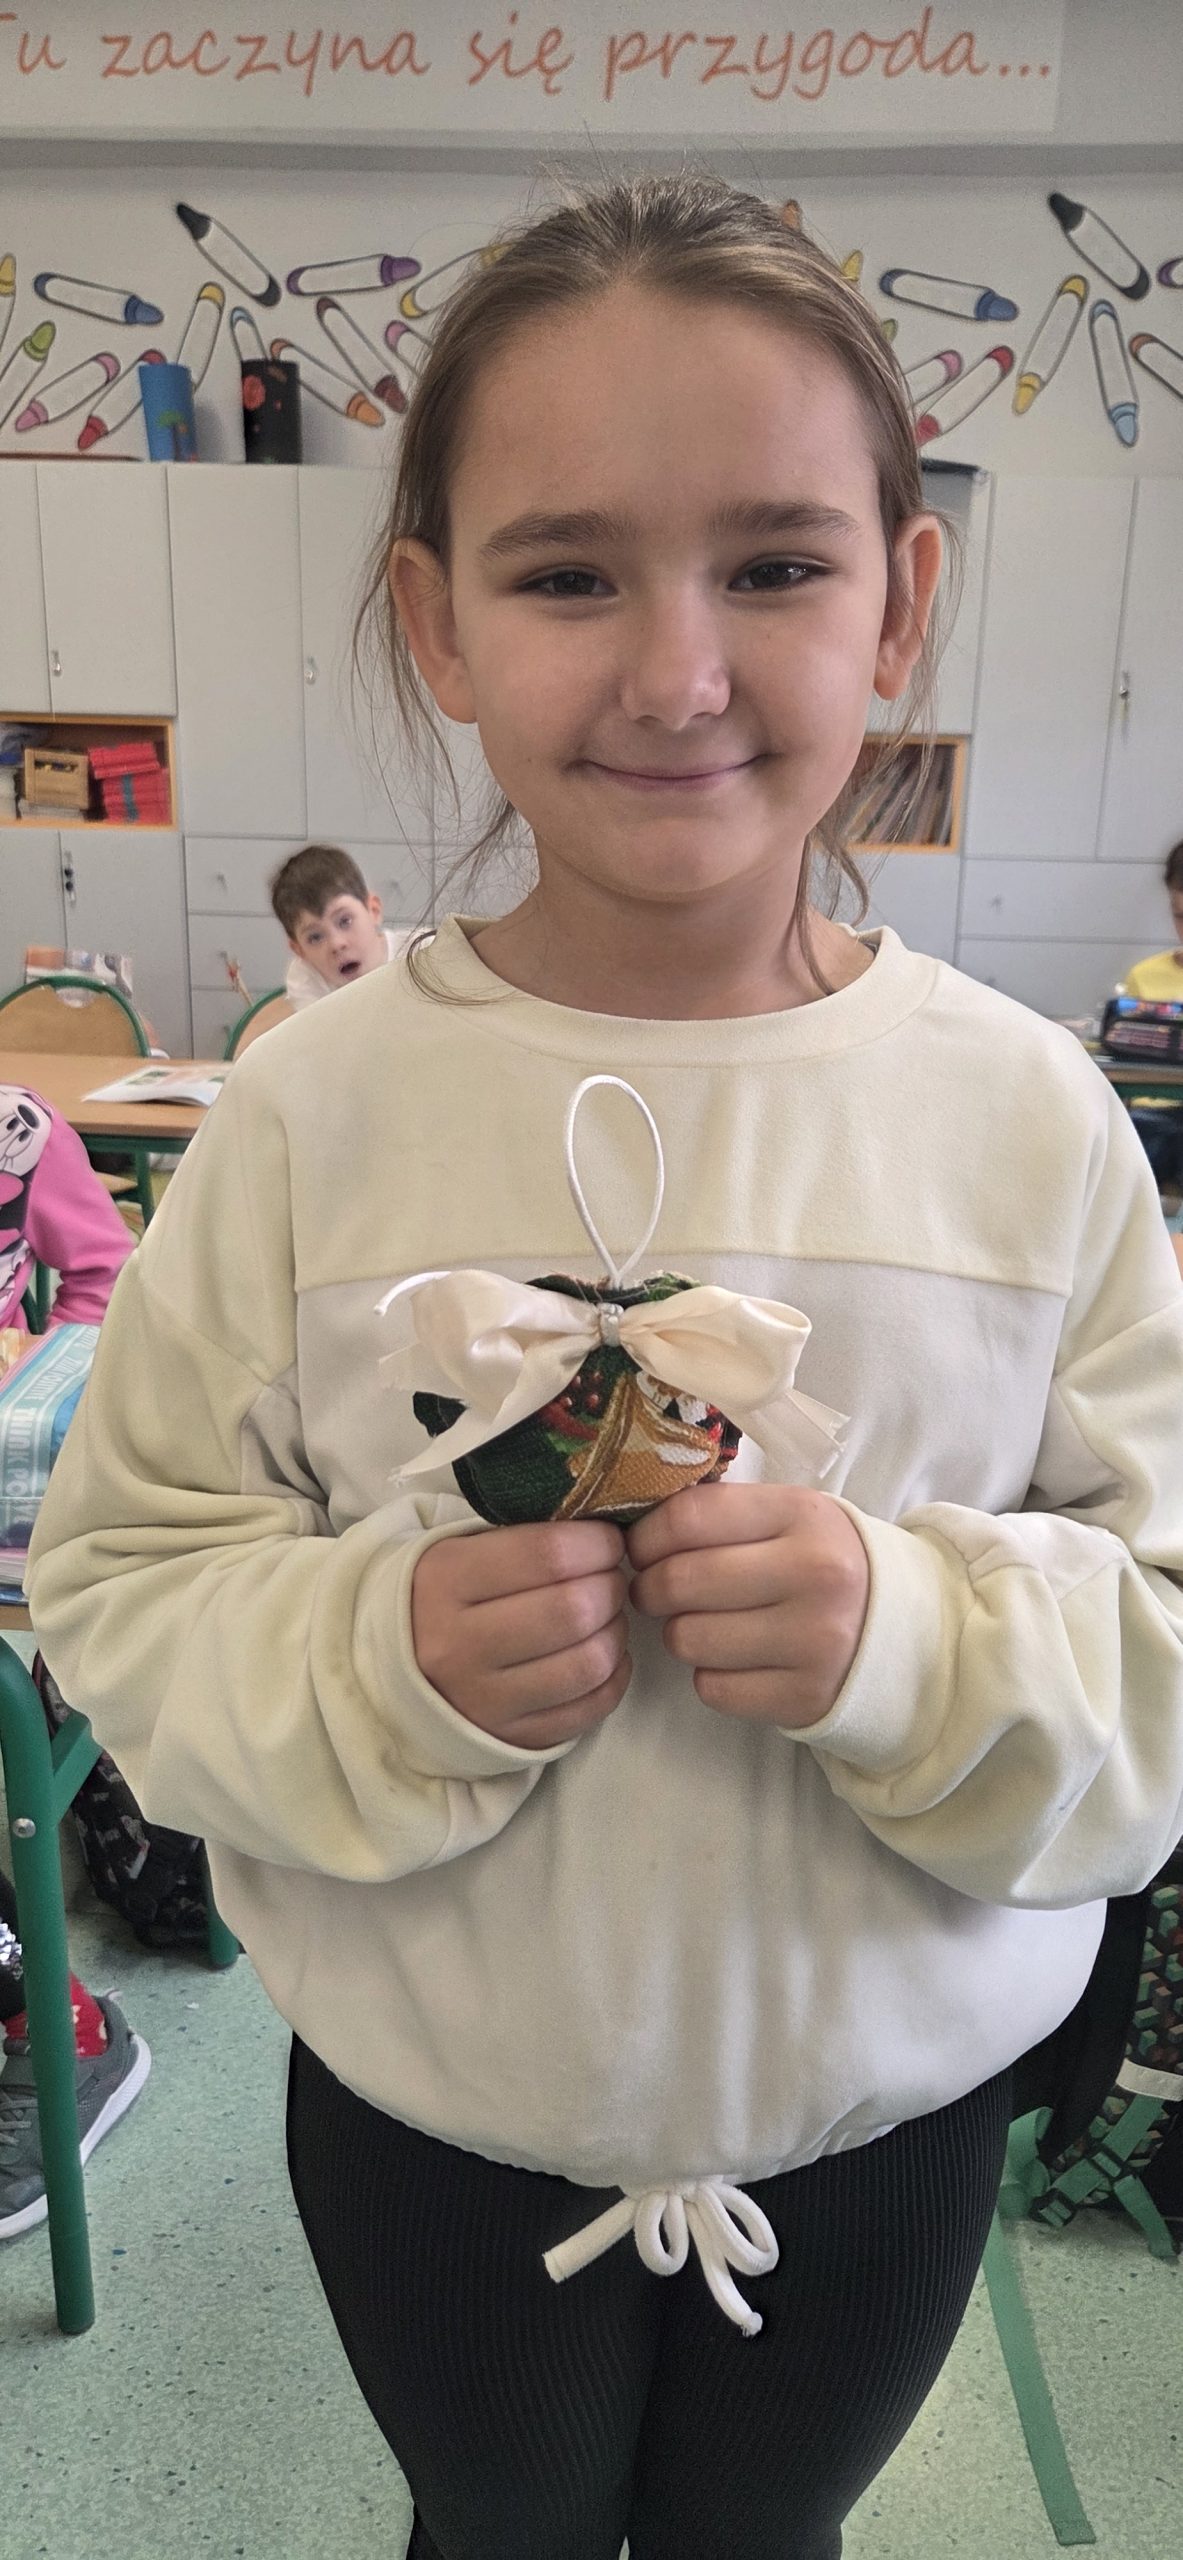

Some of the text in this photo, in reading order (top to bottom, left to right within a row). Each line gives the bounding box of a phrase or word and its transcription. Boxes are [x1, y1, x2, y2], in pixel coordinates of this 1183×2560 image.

[101, 31, 430, 96] zaczyna
[466, 12, 575, 97] się
[603, 7, 1052, 101] przygoda...
[7, 1407, 37, 1464] THINK
